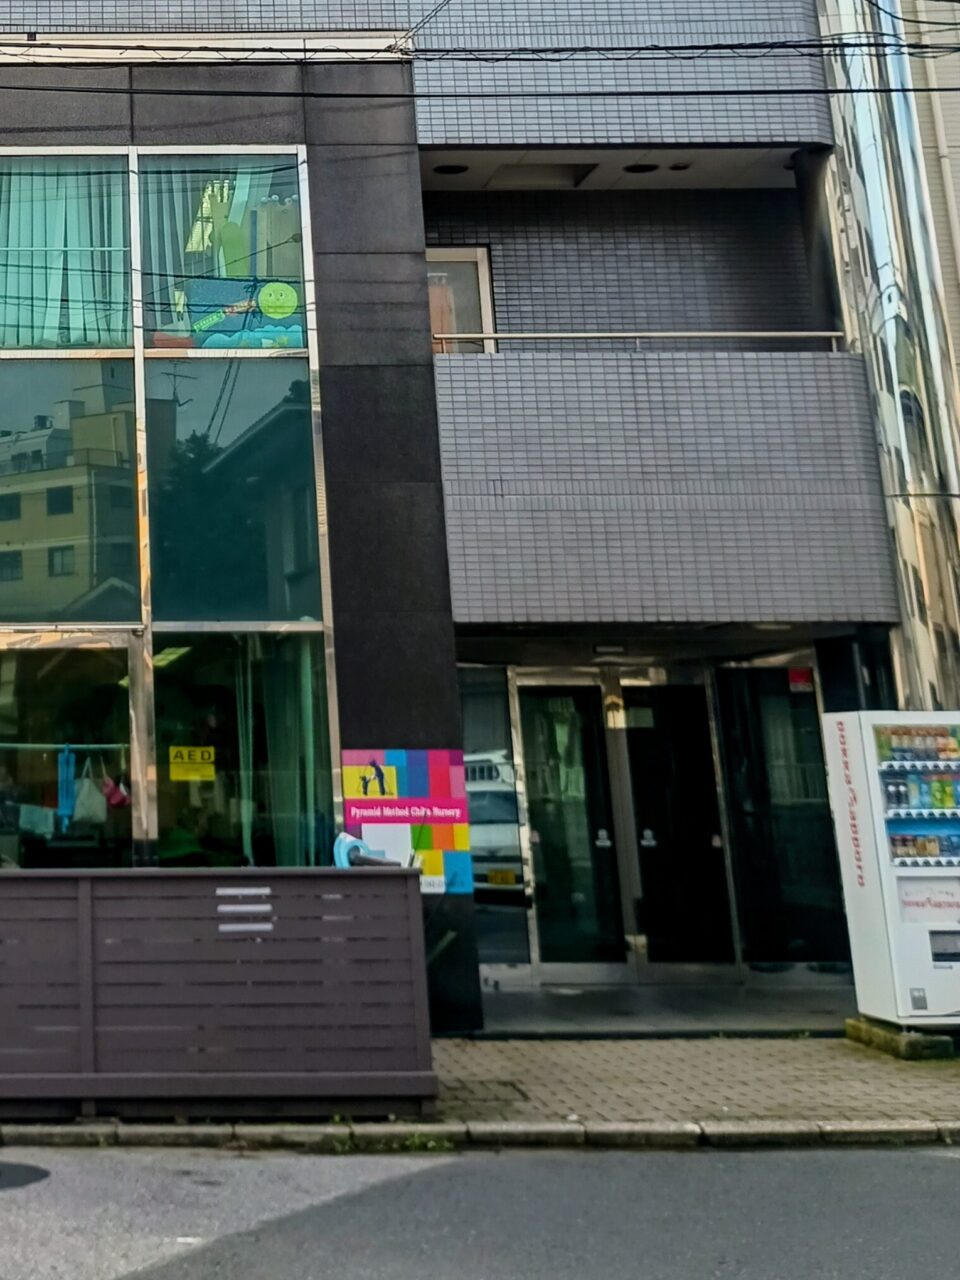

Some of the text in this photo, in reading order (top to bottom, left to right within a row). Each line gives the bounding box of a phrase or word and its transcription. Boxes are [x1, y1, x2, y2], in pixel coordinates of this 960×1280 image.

[172, 750, 211, 761] AED
[351, 806, 381, 819] Pyramid
[383, 806, 409, 817] Method
[433, 806, 462, 818] Nursery
